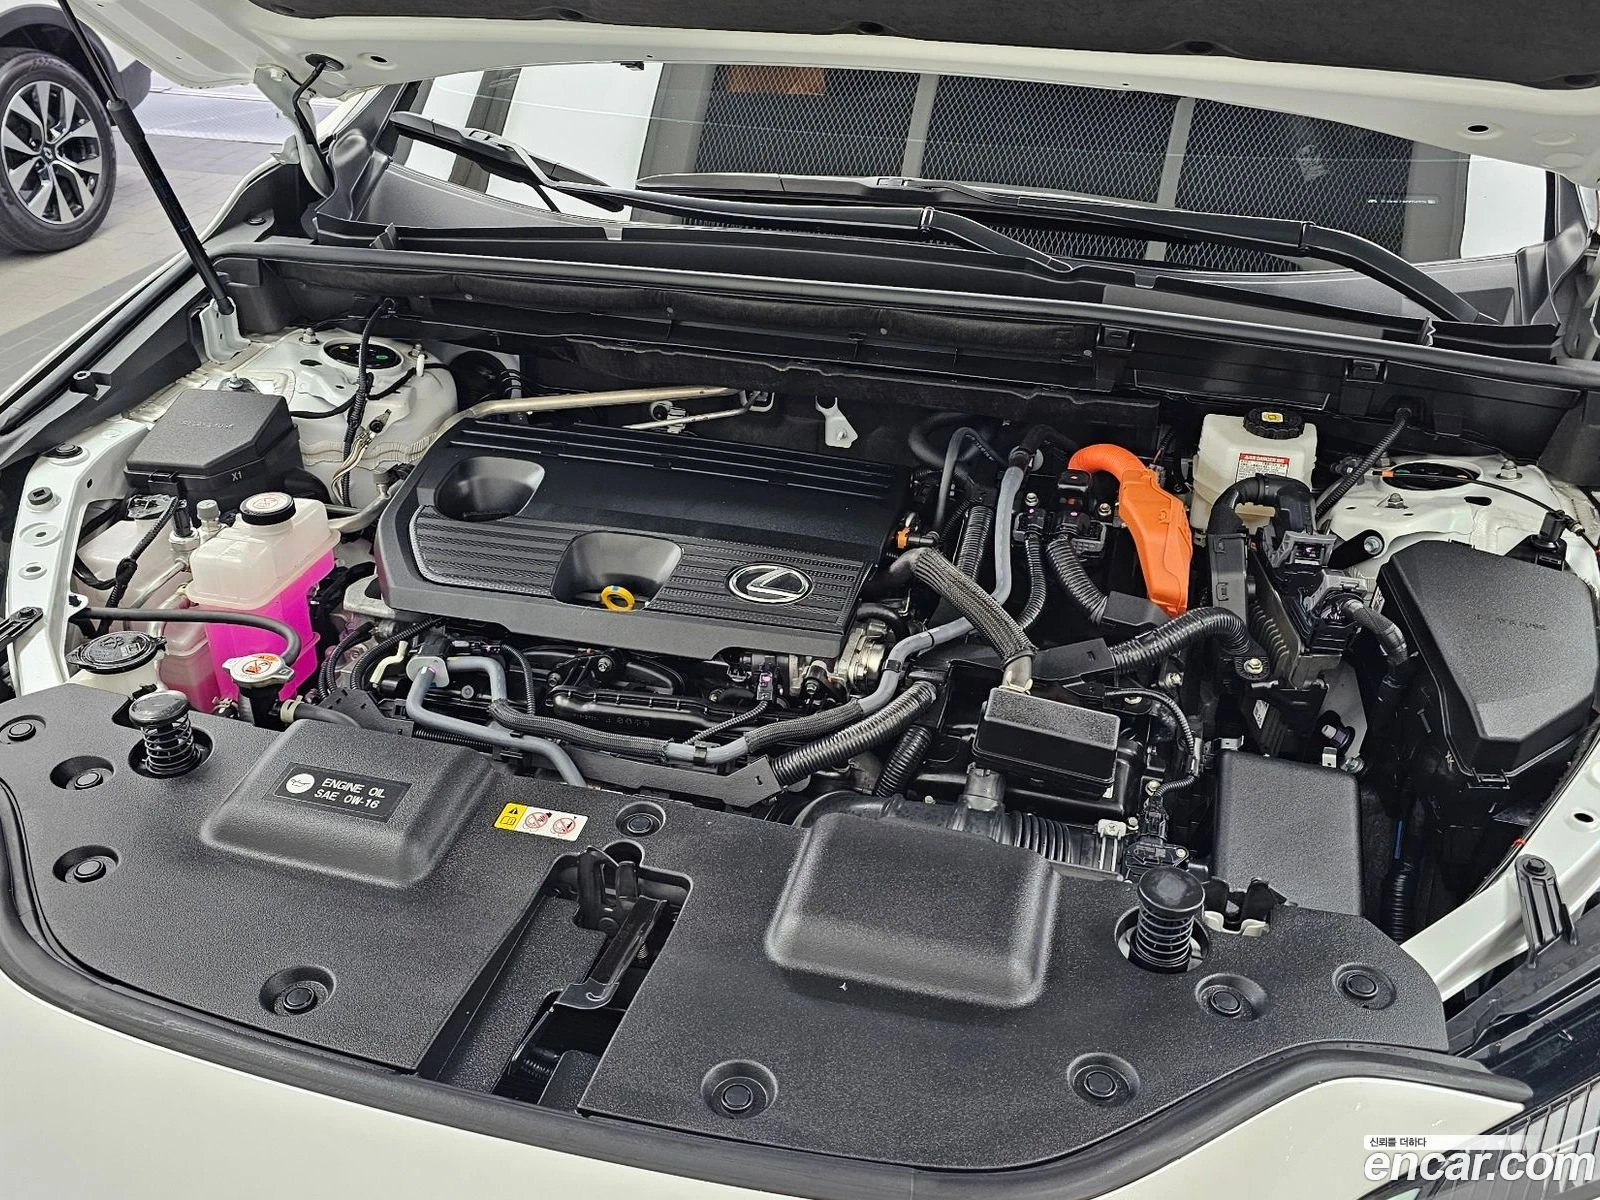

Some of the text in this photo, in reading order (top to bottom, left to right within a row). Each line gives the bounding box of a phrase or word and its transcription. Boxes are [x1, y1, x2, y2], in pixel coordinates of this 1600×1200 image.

[231, 470, 242, 481] X1
[322, 778, 385, 798] ENGINE OIL
[314, 789, 380, 809] SAE 0W-16
